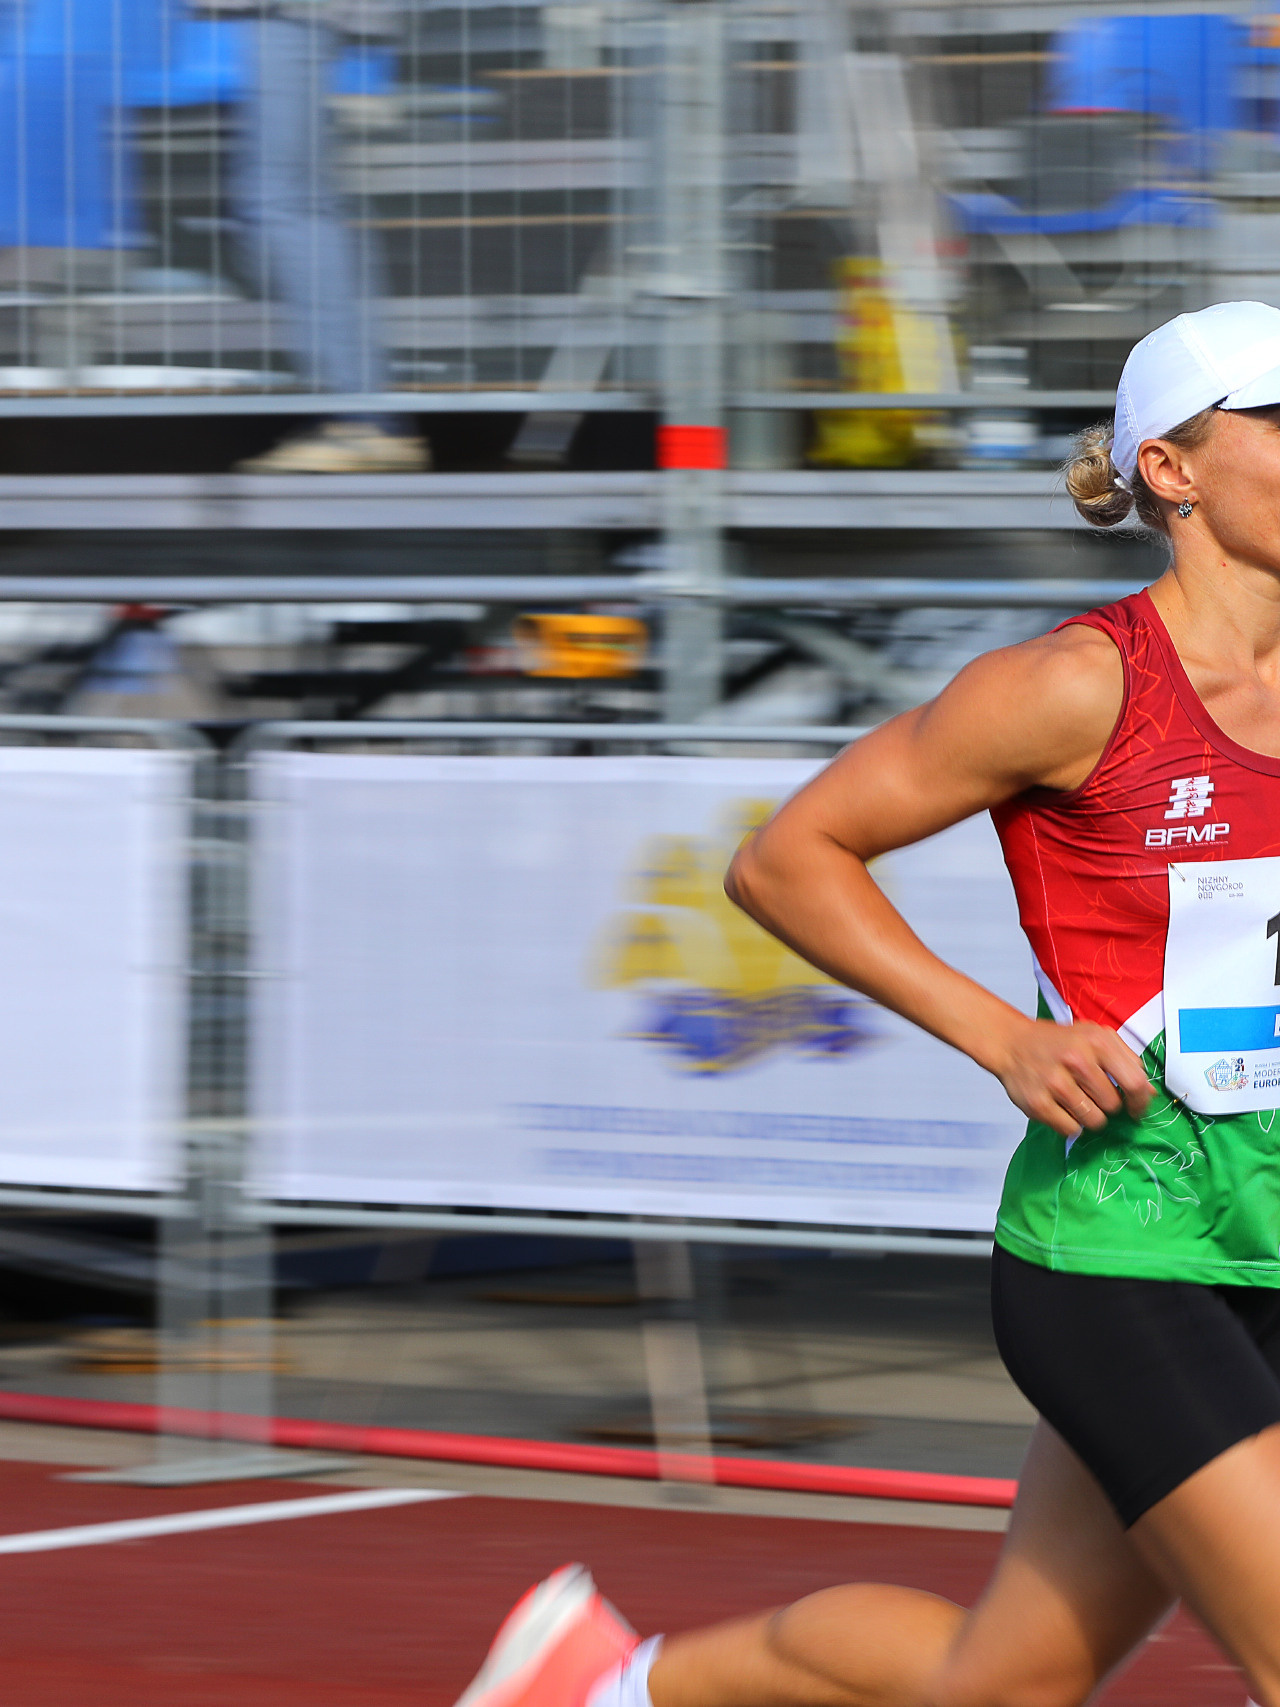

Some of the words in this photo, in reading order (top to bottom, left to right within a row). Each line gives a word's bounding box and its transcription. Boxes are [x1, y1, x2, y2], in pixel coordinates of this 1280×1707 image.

[1145, 822, 1230, 846] BFMP
[1197, 876, 1229, 884] NIZHNY
[1197, 882, 1244, 892] NOVGOROD
